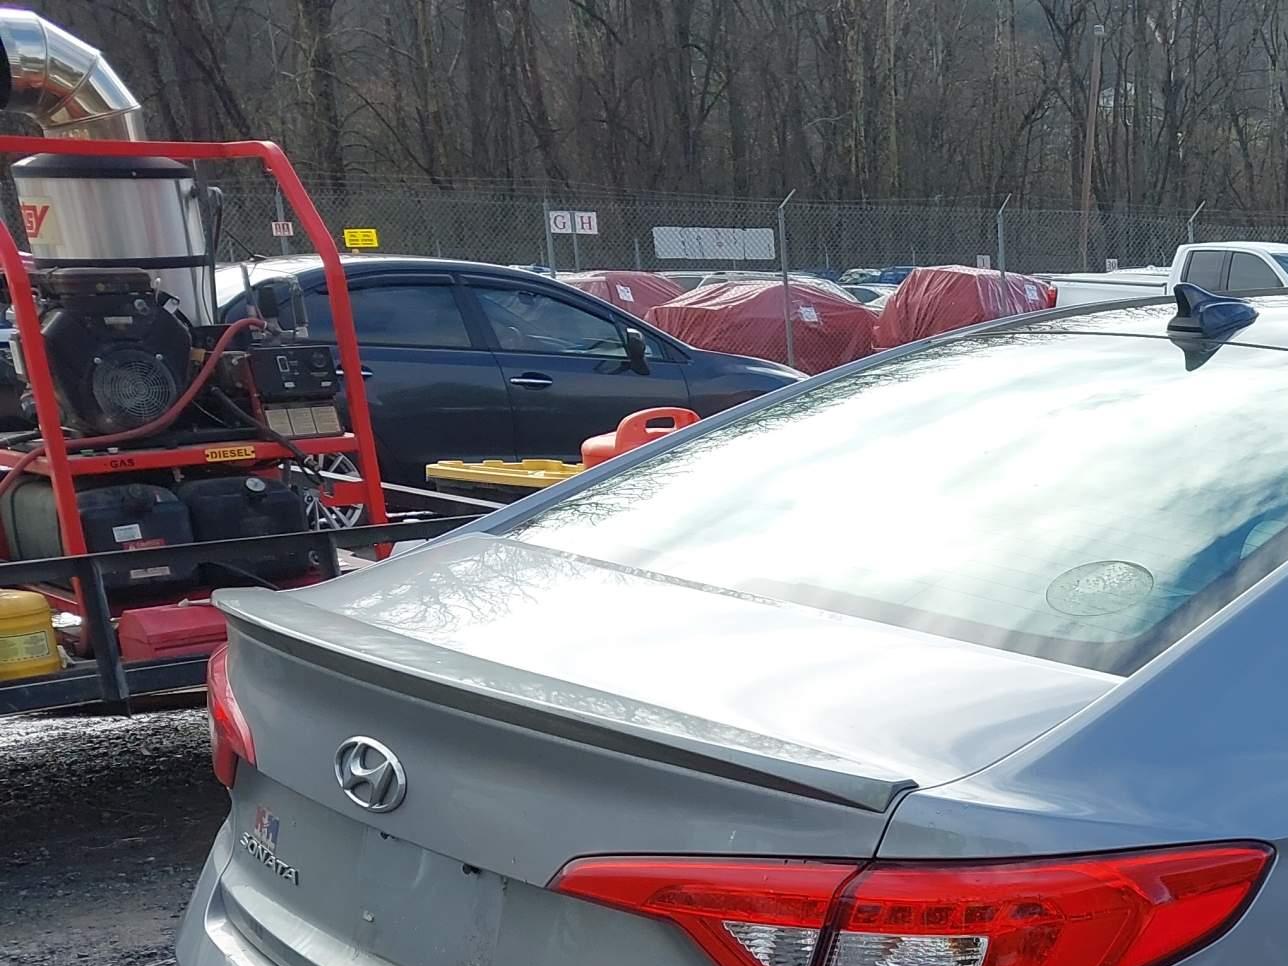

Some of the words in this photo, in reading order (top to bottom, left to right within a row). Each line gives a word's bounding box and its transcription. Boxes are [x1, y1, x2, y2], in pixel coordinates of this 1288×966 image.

[552, 214, 567, 230] G
[579, 215, 593, 231] H
[210, 449, 251, 460] DIESEL
[110, 458, 136, 469] GAS
[240, 831, 299, 887] SONATA
